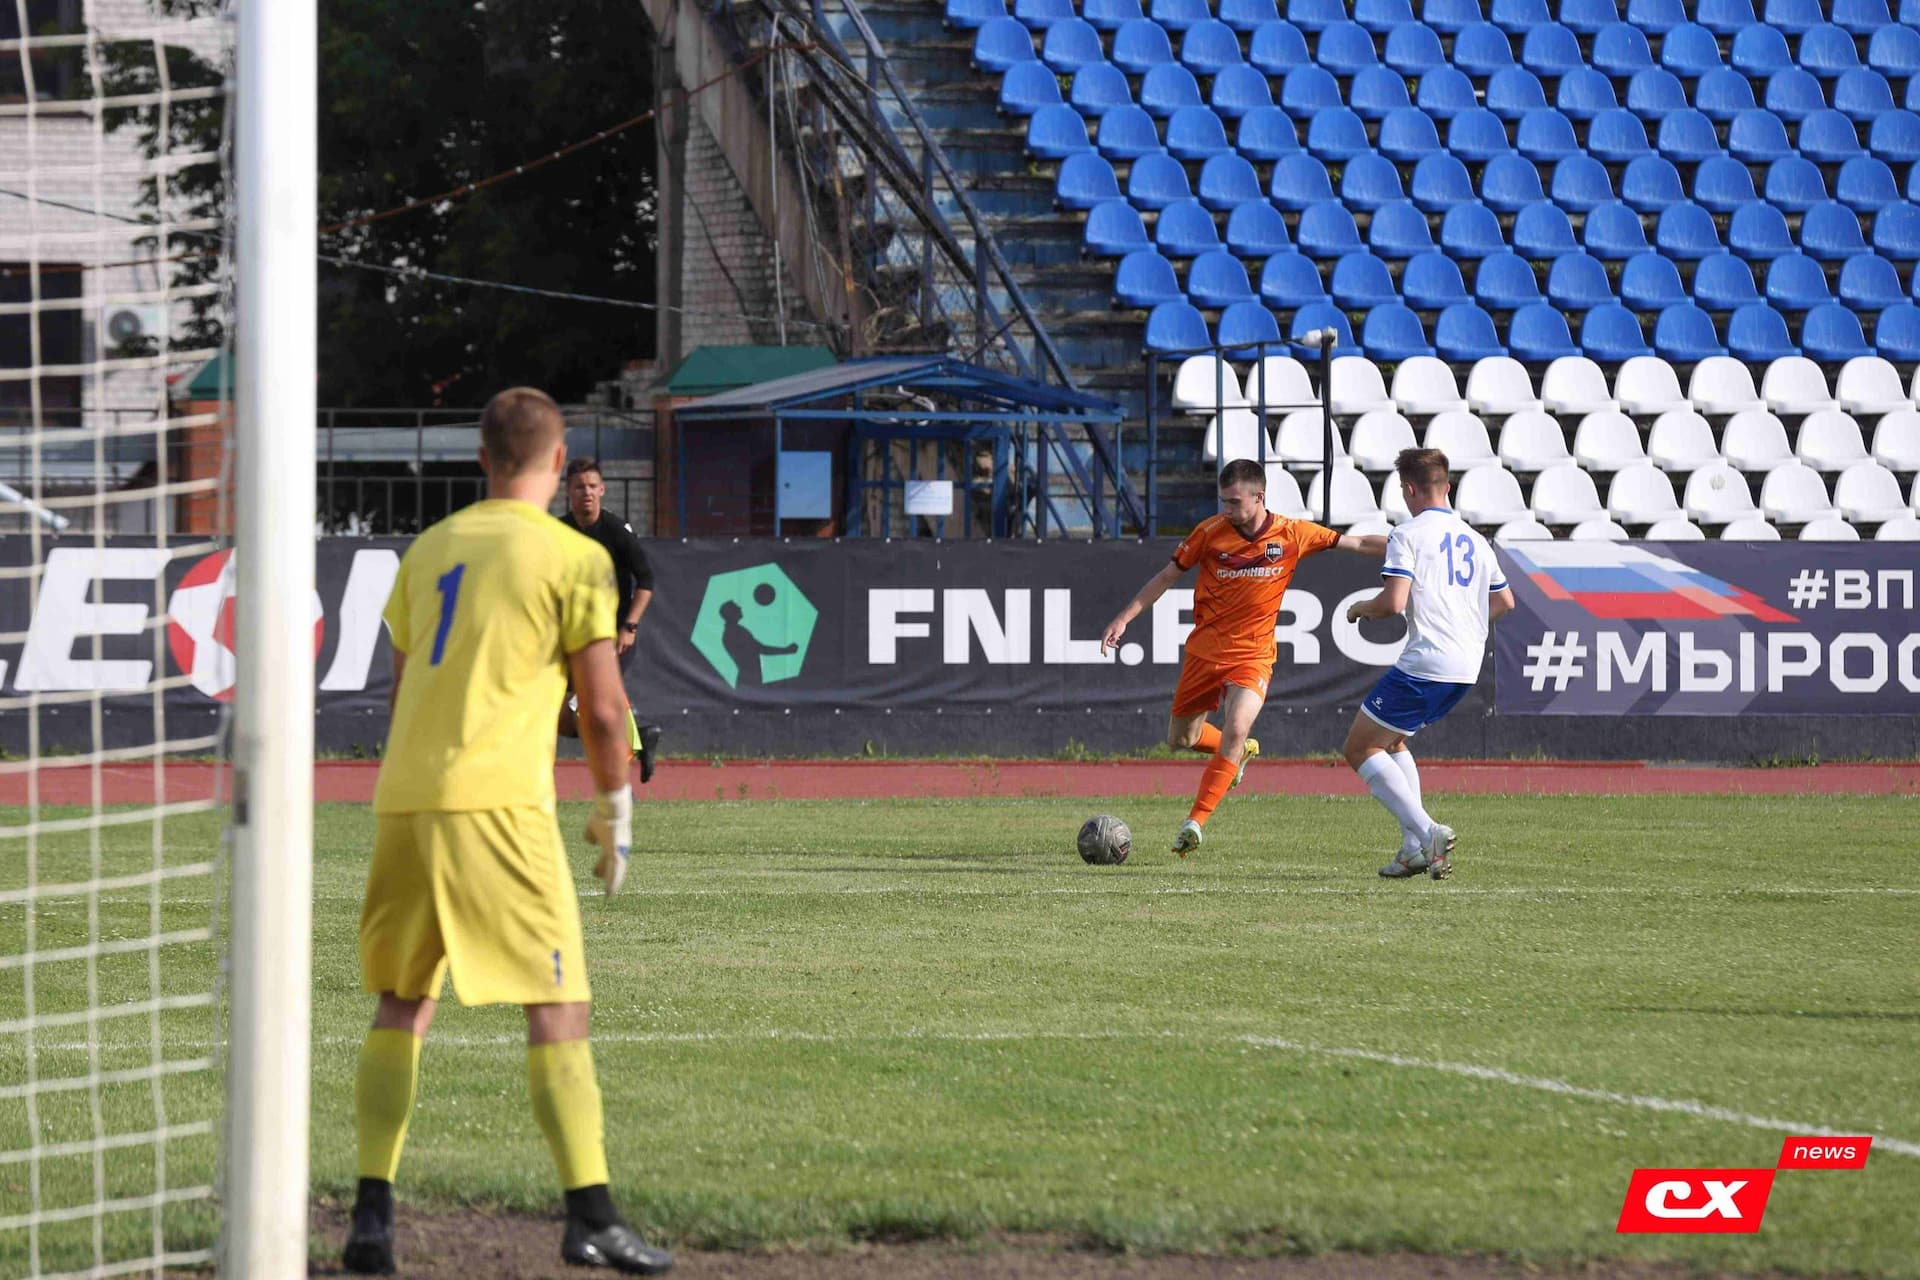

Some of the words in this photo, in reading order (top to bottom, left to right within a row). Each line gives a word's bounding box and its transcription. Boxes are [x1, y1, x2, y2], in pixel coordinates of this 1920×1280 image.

[1439, 532, 1475, 587] 13
[429, 562, 466, 667] 1
[551, 948, 562, 988] 1
